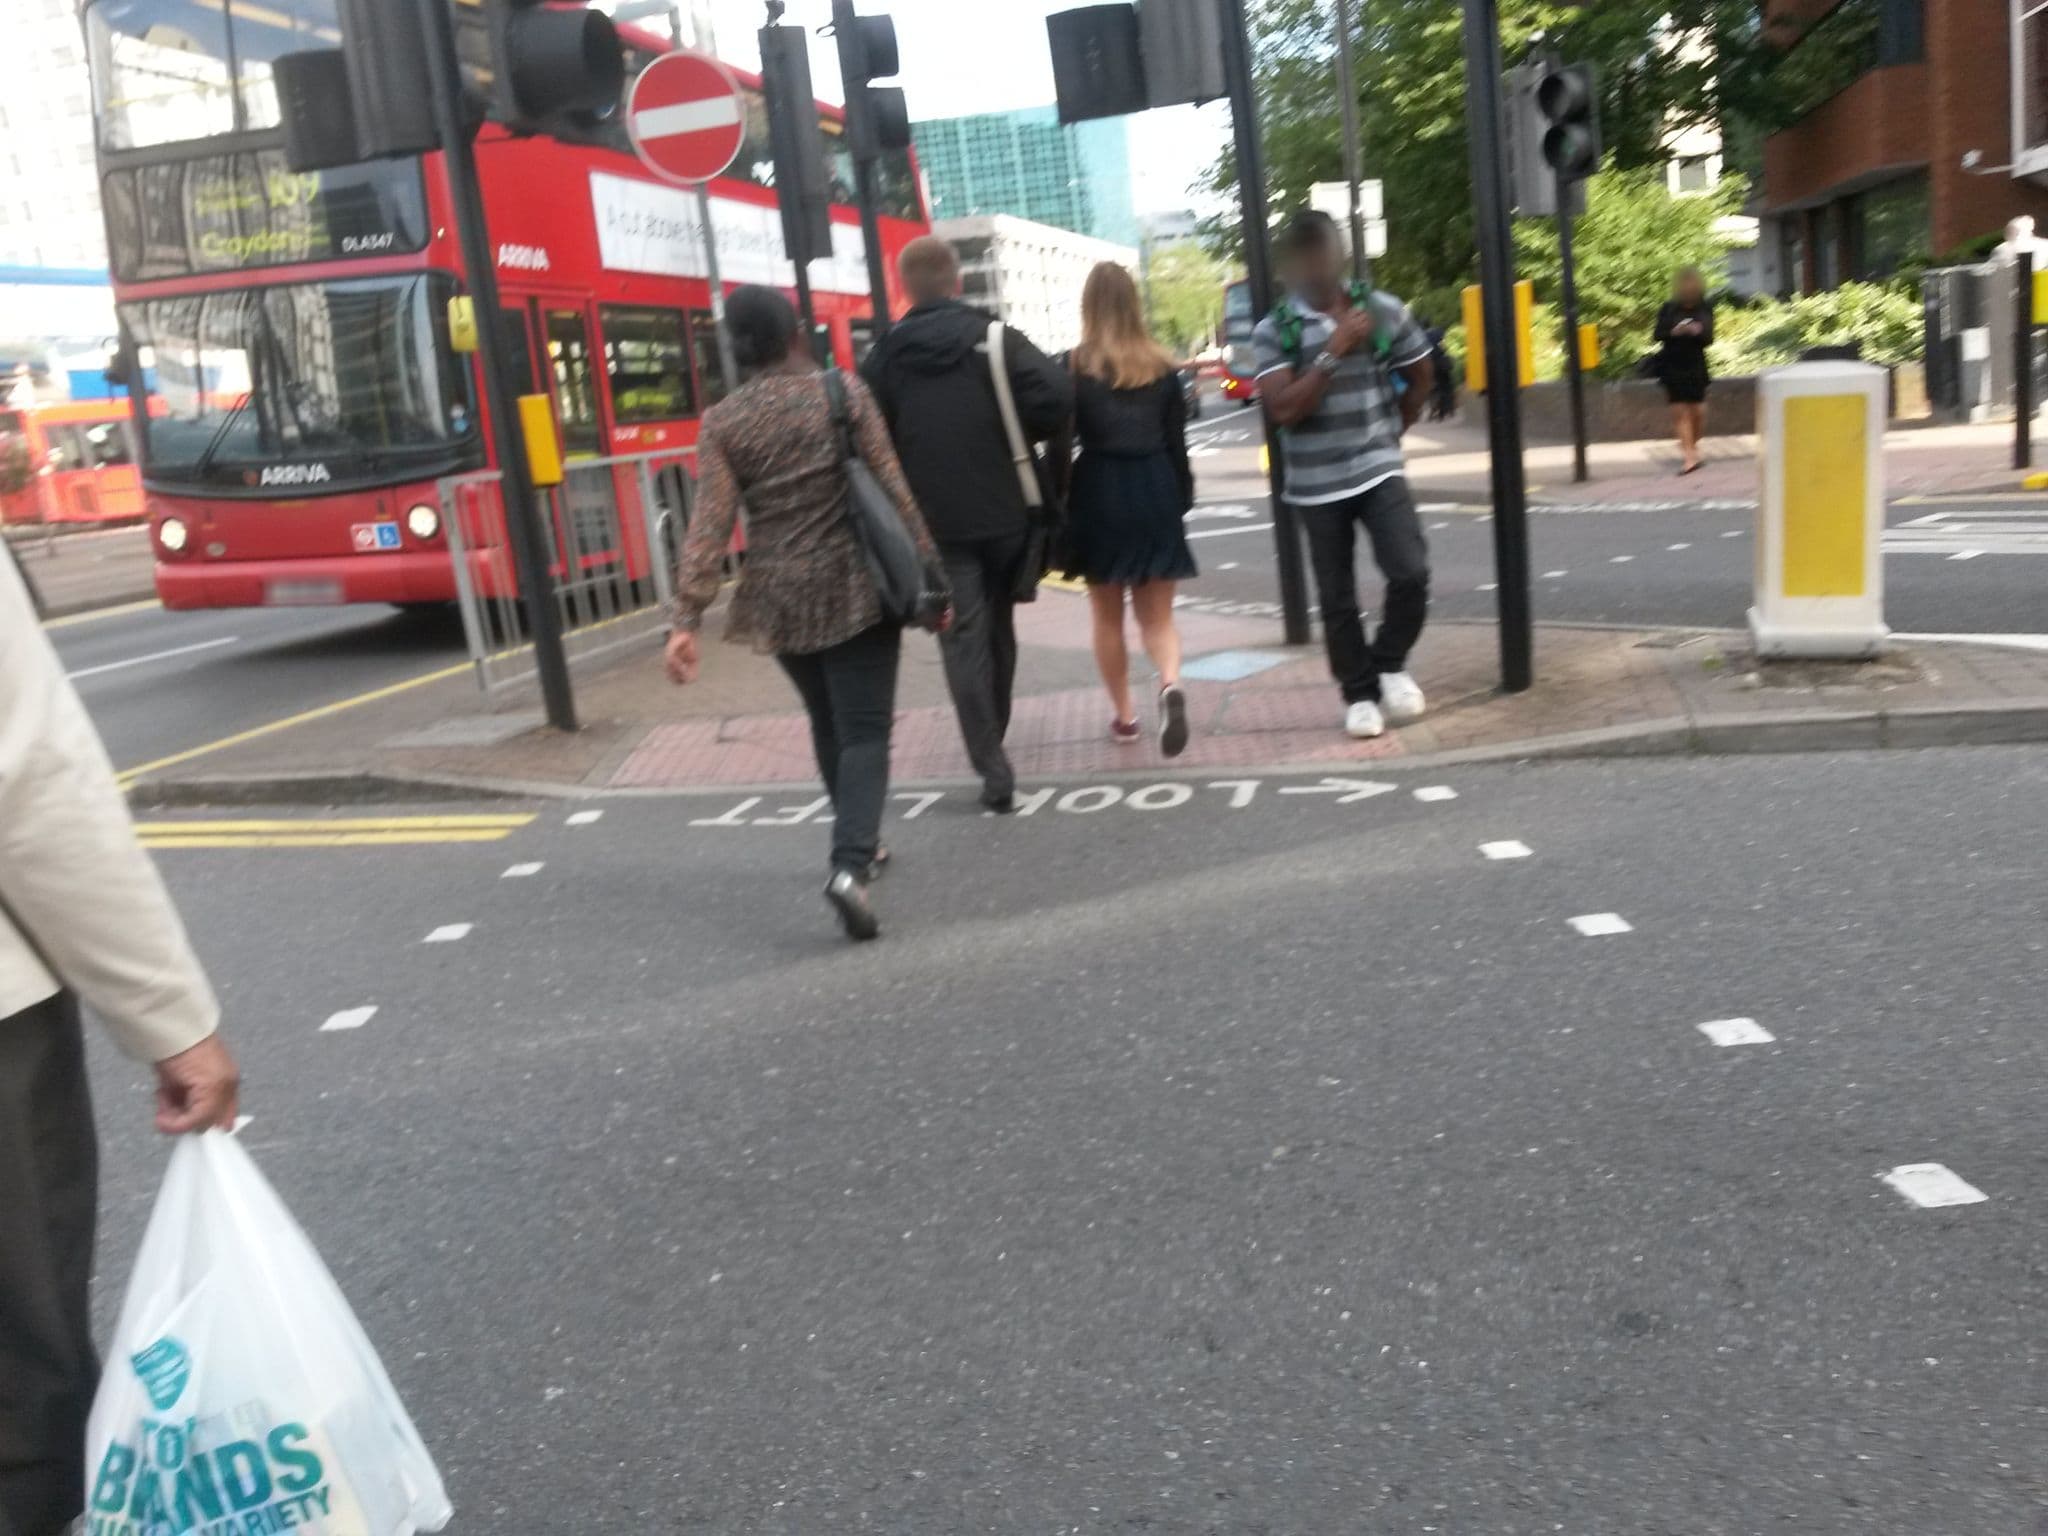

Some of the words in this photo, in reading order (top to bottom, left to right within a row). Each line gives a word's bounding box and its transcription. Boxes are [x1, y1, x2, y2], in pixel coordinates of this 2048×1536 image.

[498, 243, 551, 271] ARRIVA
[260, 463, 330, 486] ARRIVA
[687, 793, 947, 825] LFT
